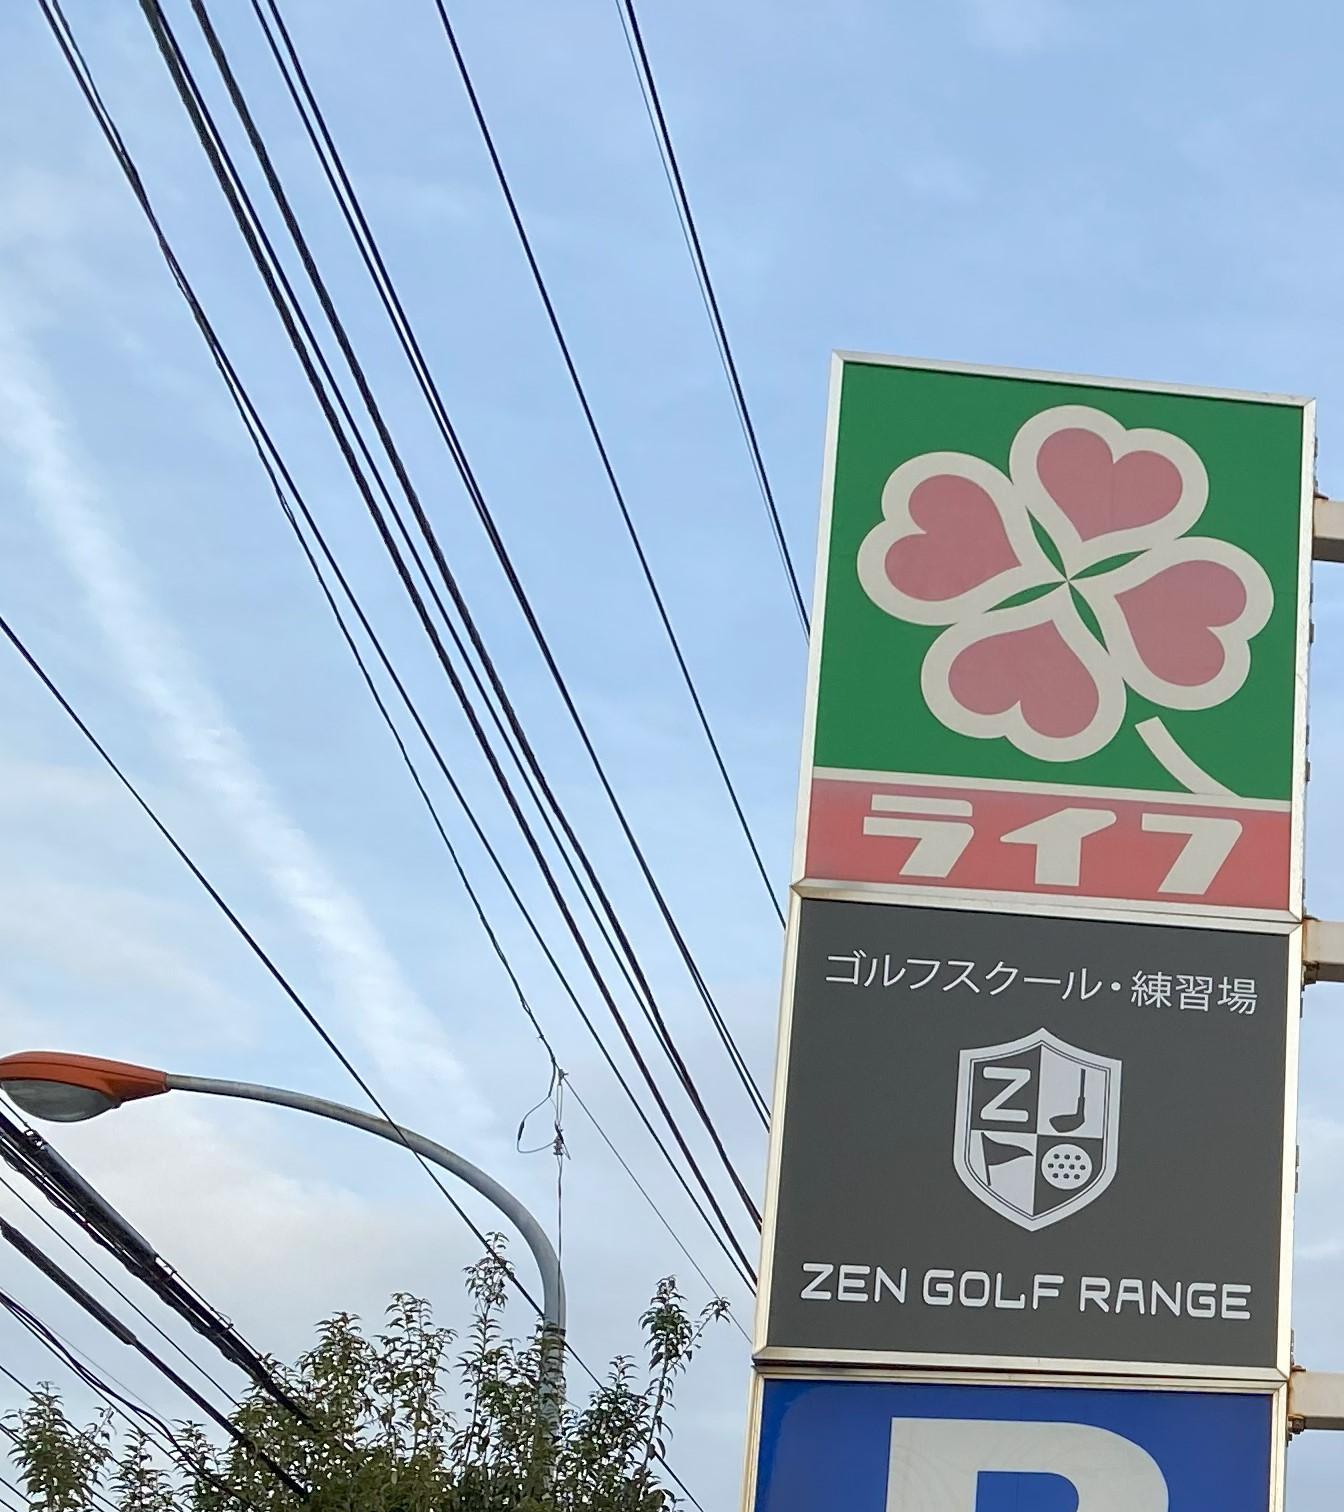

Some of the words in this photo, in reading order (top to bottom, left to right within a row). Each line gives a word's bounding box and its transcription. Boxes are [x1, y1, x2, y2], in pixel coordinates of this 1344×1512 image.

[863, 793, 1243, 895] ライフ
[825, 948, 1258, 1016] ゴルフスクール・練習場
[800, 1262, 907, 1305] ZEN
[922, 1268, 1065, 1311] GOLF
[1079, 1278, 1252, 1321] RANGE
